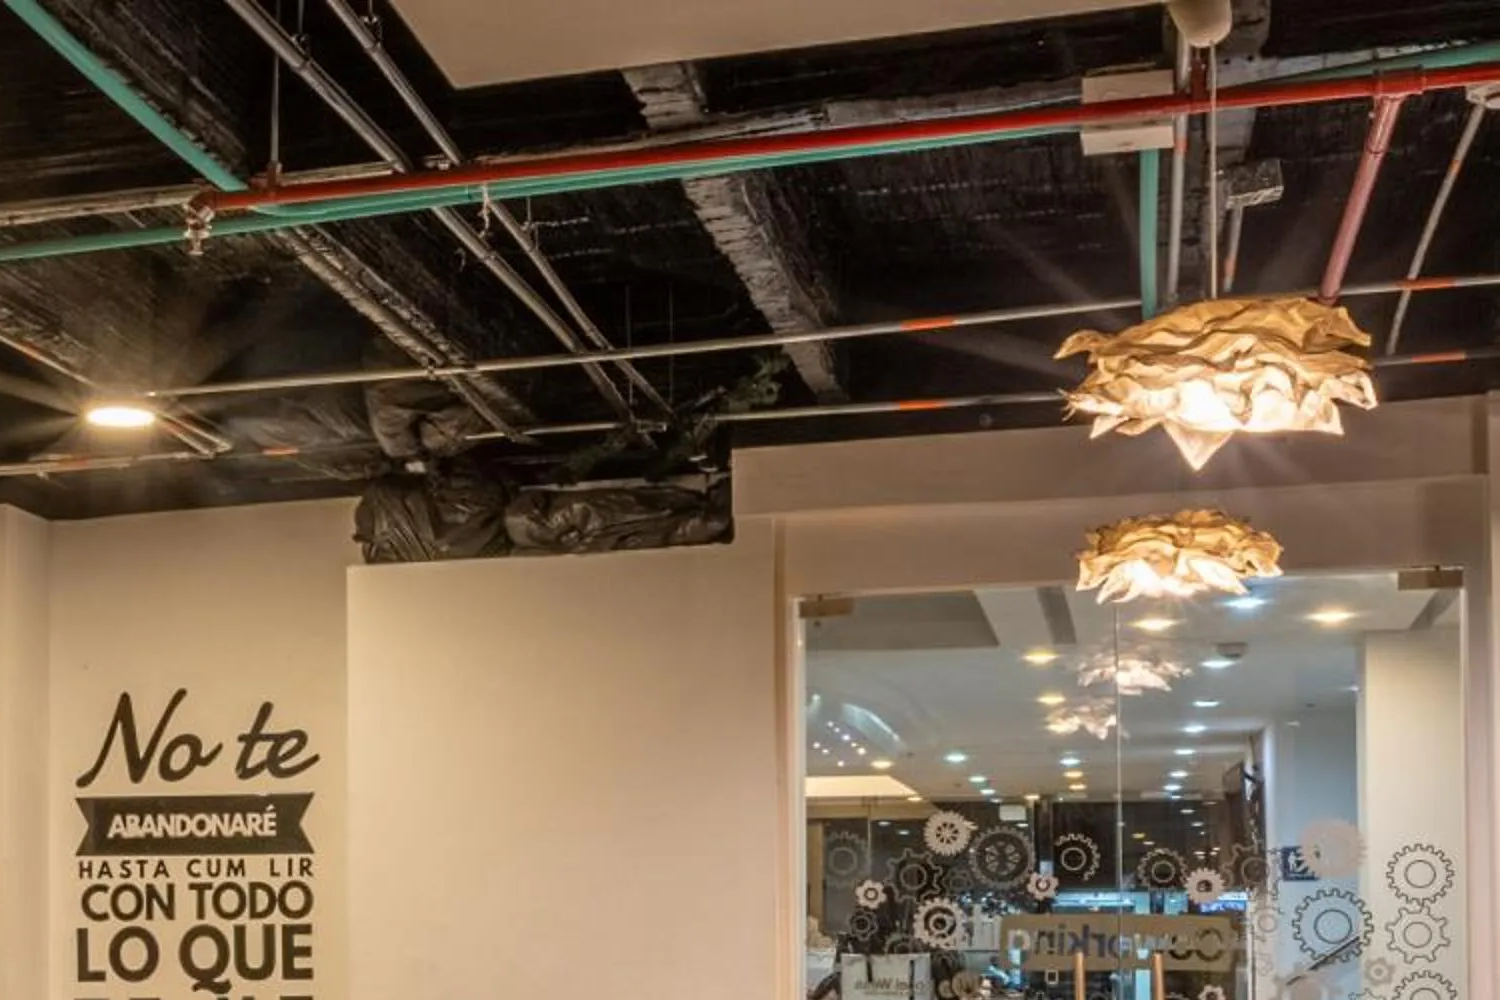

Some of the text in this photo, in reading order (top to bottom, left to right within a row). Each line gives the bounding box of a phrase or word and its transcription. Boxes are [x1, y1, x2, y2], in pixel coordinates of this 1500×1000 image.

[75, 688, 320, 789] No te
[106, 804, 277, 839] ABANDONARÉ
[78, 859, 170, 880] HASTA
[81, 881, 314, 921] CON TODO
[76, 924, 314, 994] LO QUE
